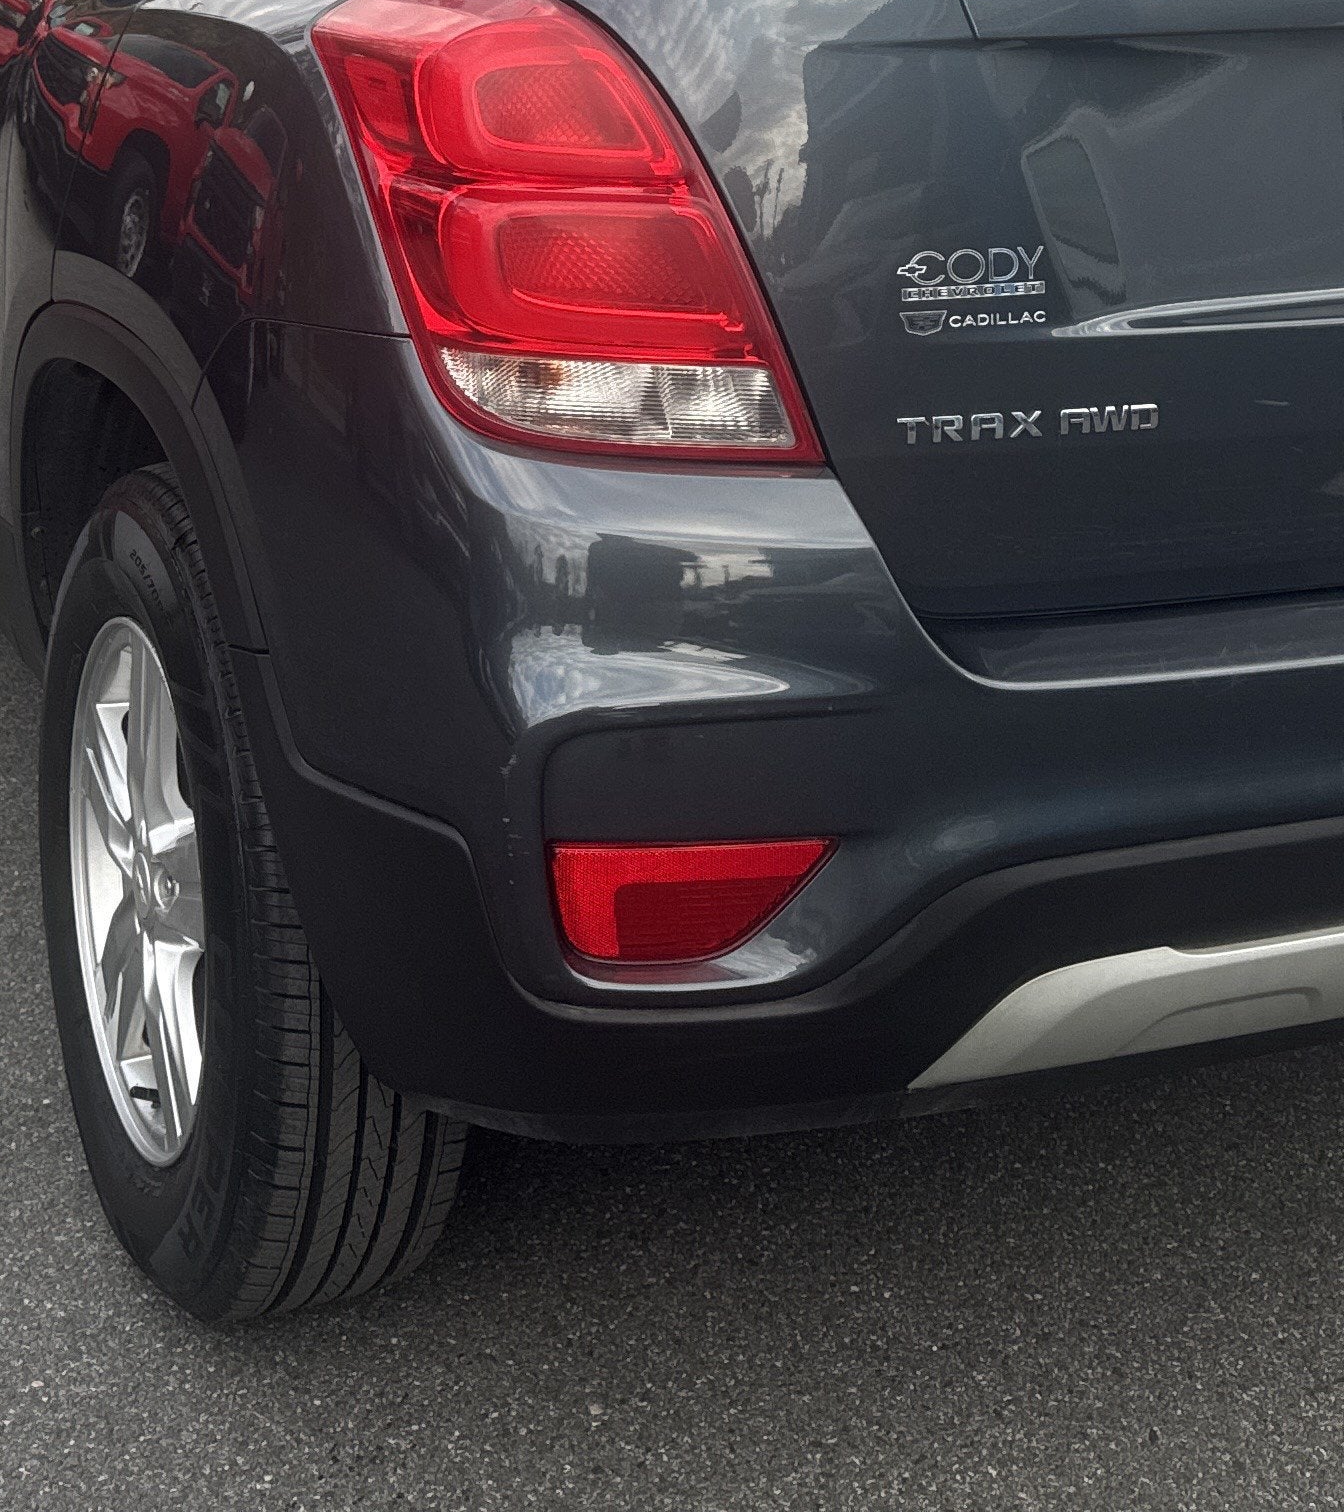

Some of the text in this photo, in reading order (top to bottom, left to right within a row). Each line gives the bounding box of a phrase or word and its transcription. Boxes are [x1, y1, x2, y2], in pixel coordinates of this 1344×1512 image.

[906, 245, 1044, 285] CODY
[905, 282, 1042, 300] CHEVROLET
[948, 310, 1047, 328] CADILLAC
[897, 403, 1159, 445] TRAX AWD
